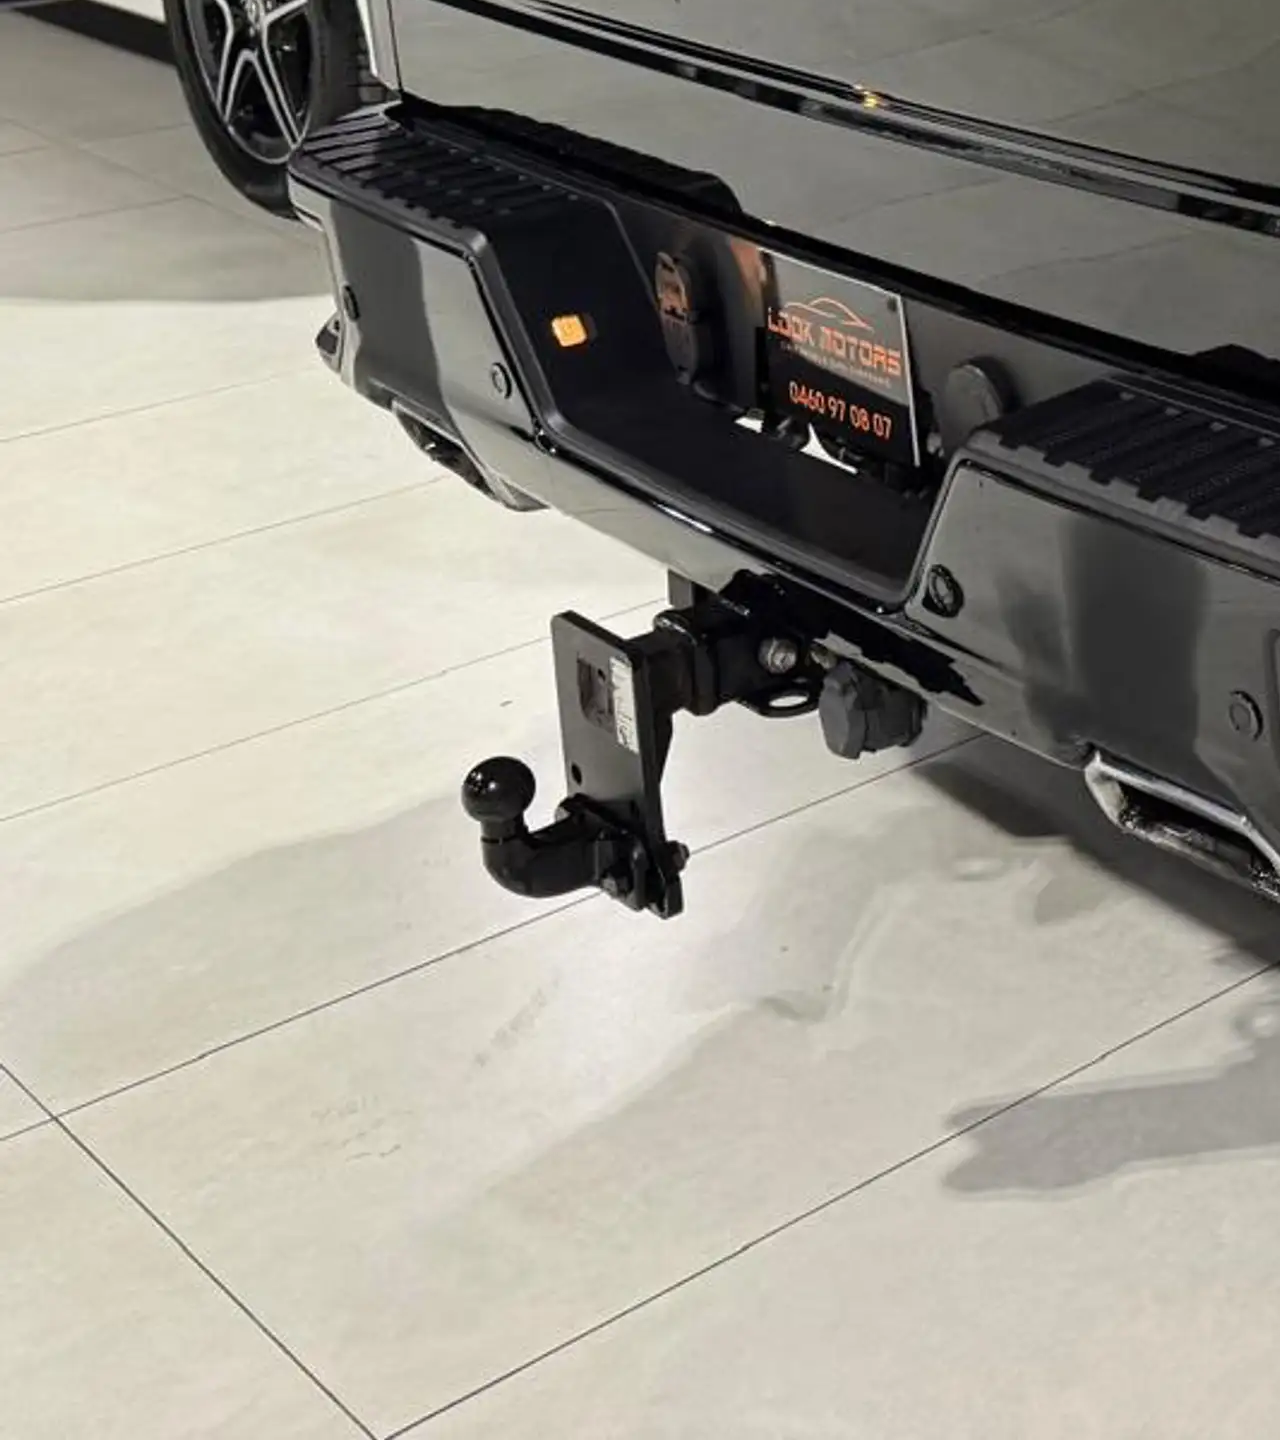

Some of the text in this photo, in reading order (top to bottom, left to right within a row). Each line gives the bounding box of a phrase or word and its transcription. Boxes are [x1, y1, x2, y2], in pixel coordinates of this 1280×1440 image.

[767, 306, 815, 347] LOOK
[818, 325, 902, 377] MOTORS
[788, 380, 893, 441] 0460 97 08 07
